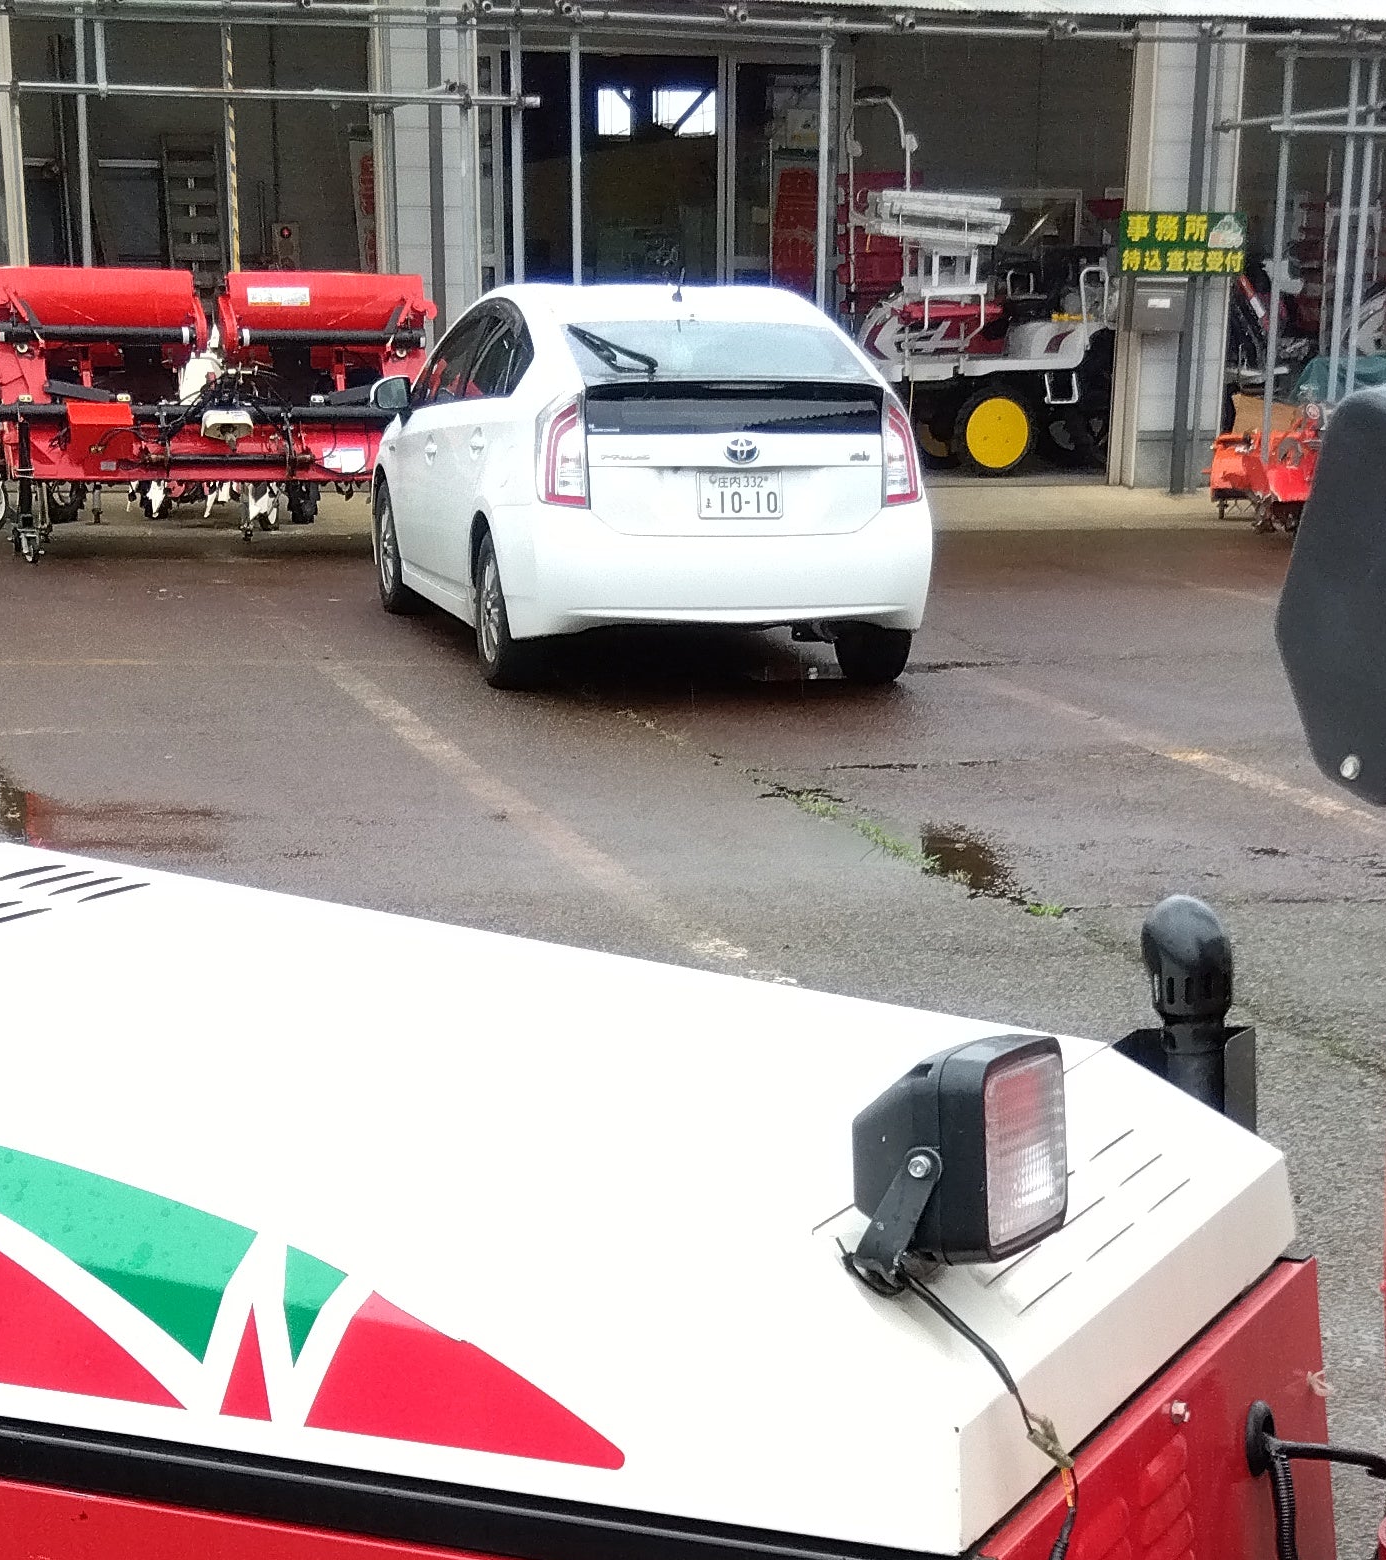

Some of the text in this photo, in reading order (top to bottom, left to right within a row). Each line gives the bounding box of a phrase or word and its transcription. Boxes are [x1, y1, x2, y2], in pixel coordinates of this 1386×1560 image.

[1127, 214, 1207, 242] 事務所
[743, 476, 764, 488] 332
[720, 491, 778, 514] 10-10
